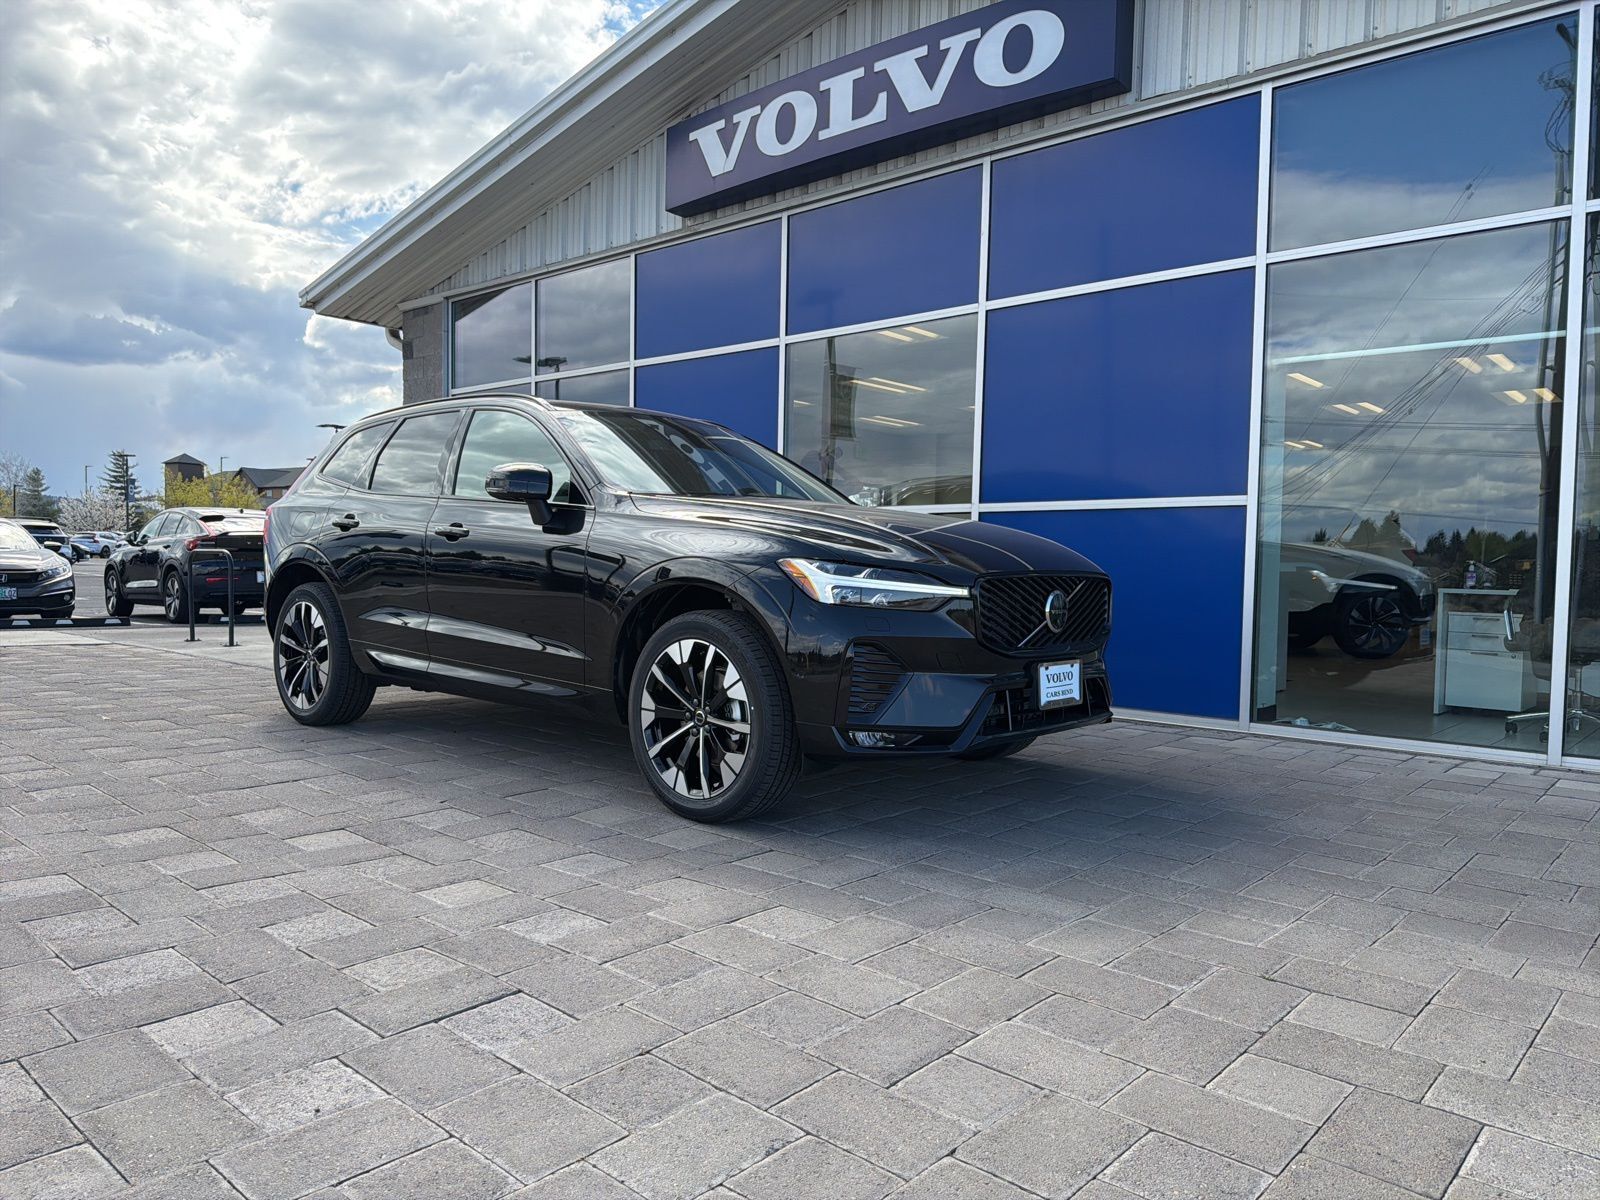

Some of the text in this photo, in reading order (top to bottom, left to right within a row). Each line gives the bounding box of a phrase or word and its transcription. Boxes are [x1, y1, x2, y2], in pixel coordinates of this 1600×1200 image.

[688, 9, 1065, 178] VOLVO
[1046, 671, 1074, 684] VOLVO
[1046, 690, 1061, 699] CARS
